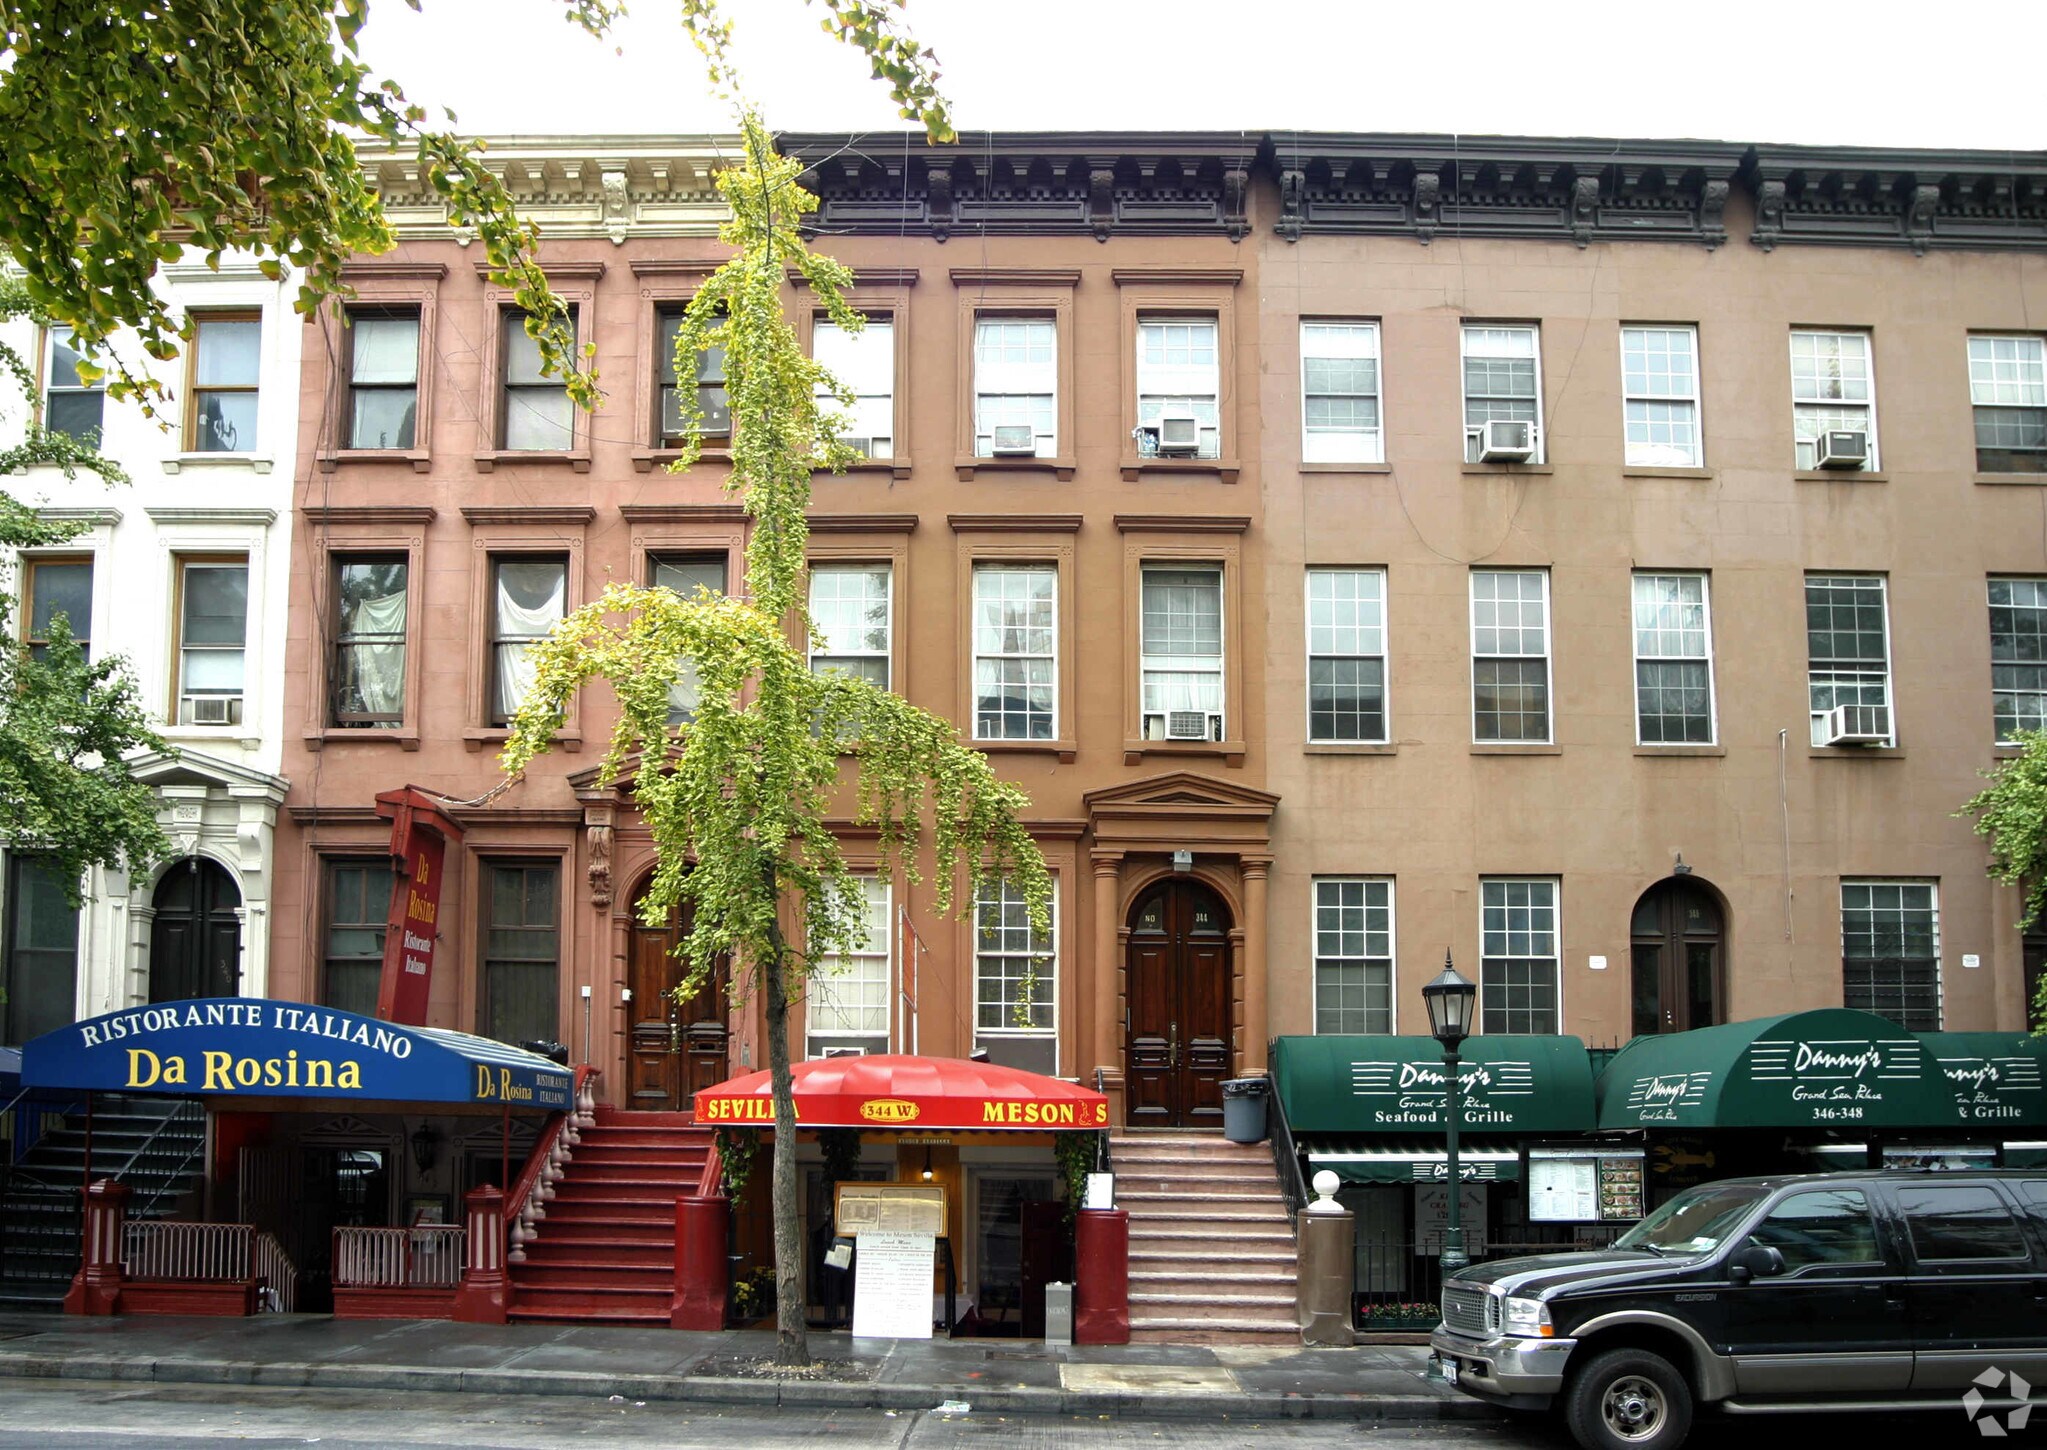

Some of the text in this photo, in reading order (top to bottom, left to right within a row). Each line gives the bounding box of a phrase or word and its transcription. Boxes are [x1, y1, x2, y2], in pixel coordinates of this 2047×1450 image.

[417, 853, 429, 885] Da
[408, 890, 435, 924] Rosina
[80, 1004, 412, 1059] RISTORANTE ITALIANO
[126, 1048, 363, 1090] Da Rosina
[1794, 1041, 1882, 1078] Danny's
[477, 1064, 533, 1101] Da Rosina
[536, 1073, 568, 1090] RISTORANTE
[1399, 1062, 1491, 1094] Dany's
[540, 1090, 565, 1104] ITALIANO
[1399, 1096, 1435, 1108] Grand
[1462, 1095, 1491, 1108] Palace
[1645, 1077, 1688, 1105] Danny's
[1792, 1083, 1883, 1101] Grand Sea Palace
[867, 1105, 892, 1117] 344
[896, 1105, 914, 1117] W.
[983, 1102, 1074, 1123] MESON
[1375, 1110, 1437, 1122] Seafood
[1464, 1110, 1513, 1122] Grille
[1812, 1106, 1863, 1120] 346-348
[1958, 1106, 2022, 1118] & Grille
[1674, 1293, 1718, 1302] EXCURSION
